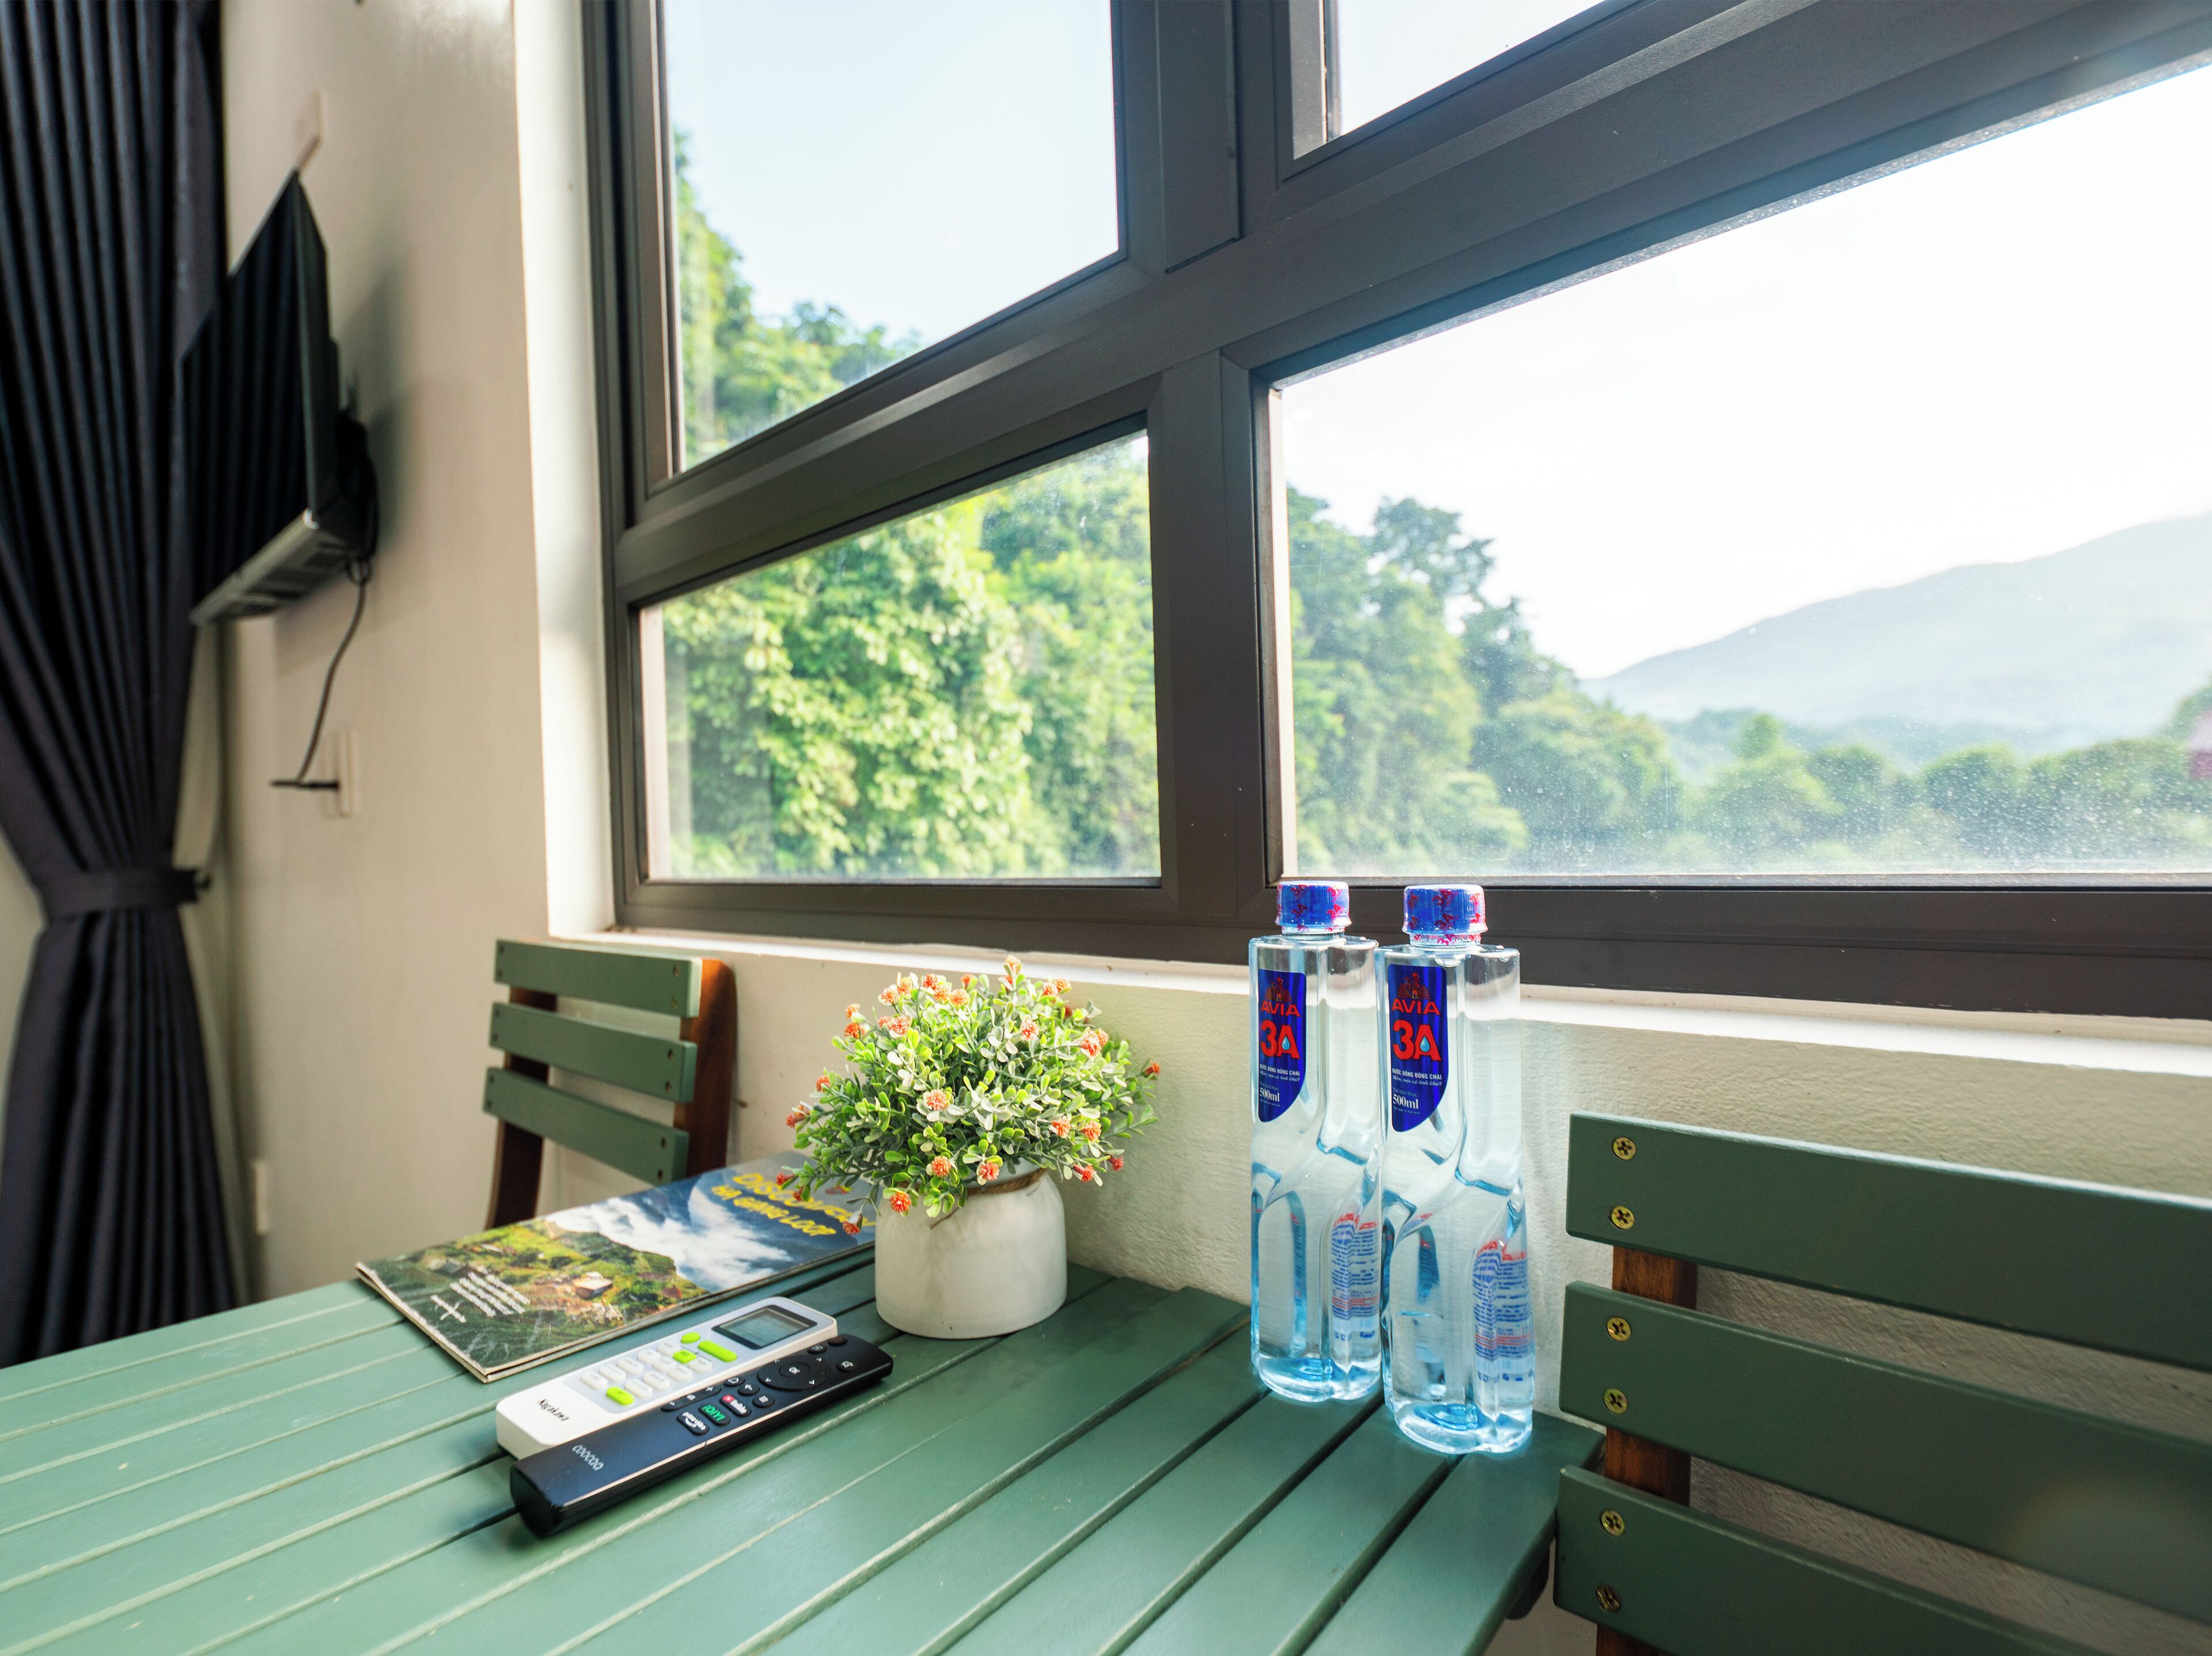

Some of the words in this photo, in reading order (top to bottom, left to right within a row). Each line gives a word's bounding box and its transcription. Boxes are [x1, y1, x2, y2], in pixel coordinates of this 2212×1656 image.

[1291, 903, 1308, 918] 3A
[1260, 1001, 1301, 1017] AVIA
[1391, 998, 1441, 1016] AVIA
[1260, 1020, 1301, 1059] 3A
[1392, 1019, 1442, 1062] 3A
[1259, 1087, 1280, 1102] 500ml
[1392, 1093, 1419, 1110] 500ml
[779, 1214, 838, 1237] LOOP
